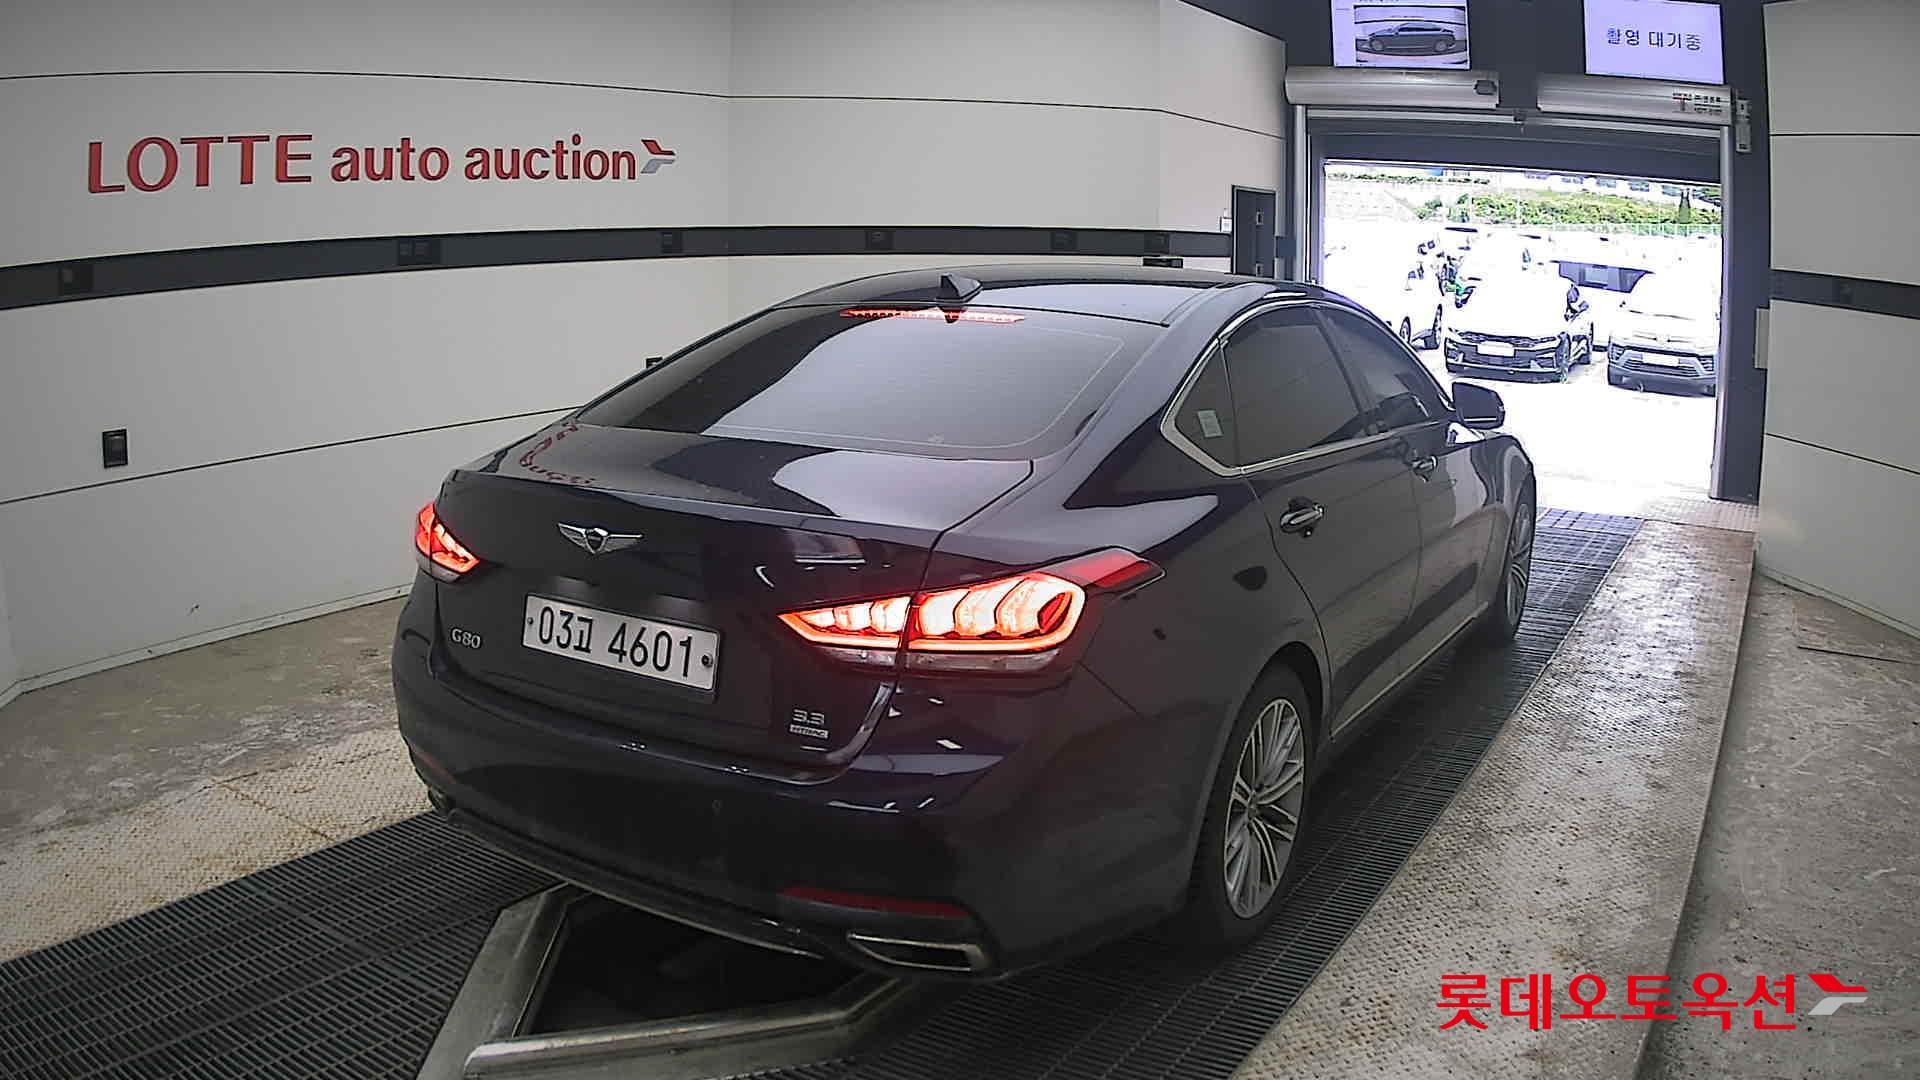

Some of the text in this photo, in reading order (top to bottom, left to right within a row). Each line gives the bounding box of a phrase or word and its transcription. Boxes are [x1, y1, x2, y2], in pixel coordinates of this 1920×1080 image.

[88, 133, 636, 194] LOTTE auto auction
[451, 628, 482, 649] G80
[538, 606, 693, 677] 03고 4601
[793, 709, 825, 725] 3.3
